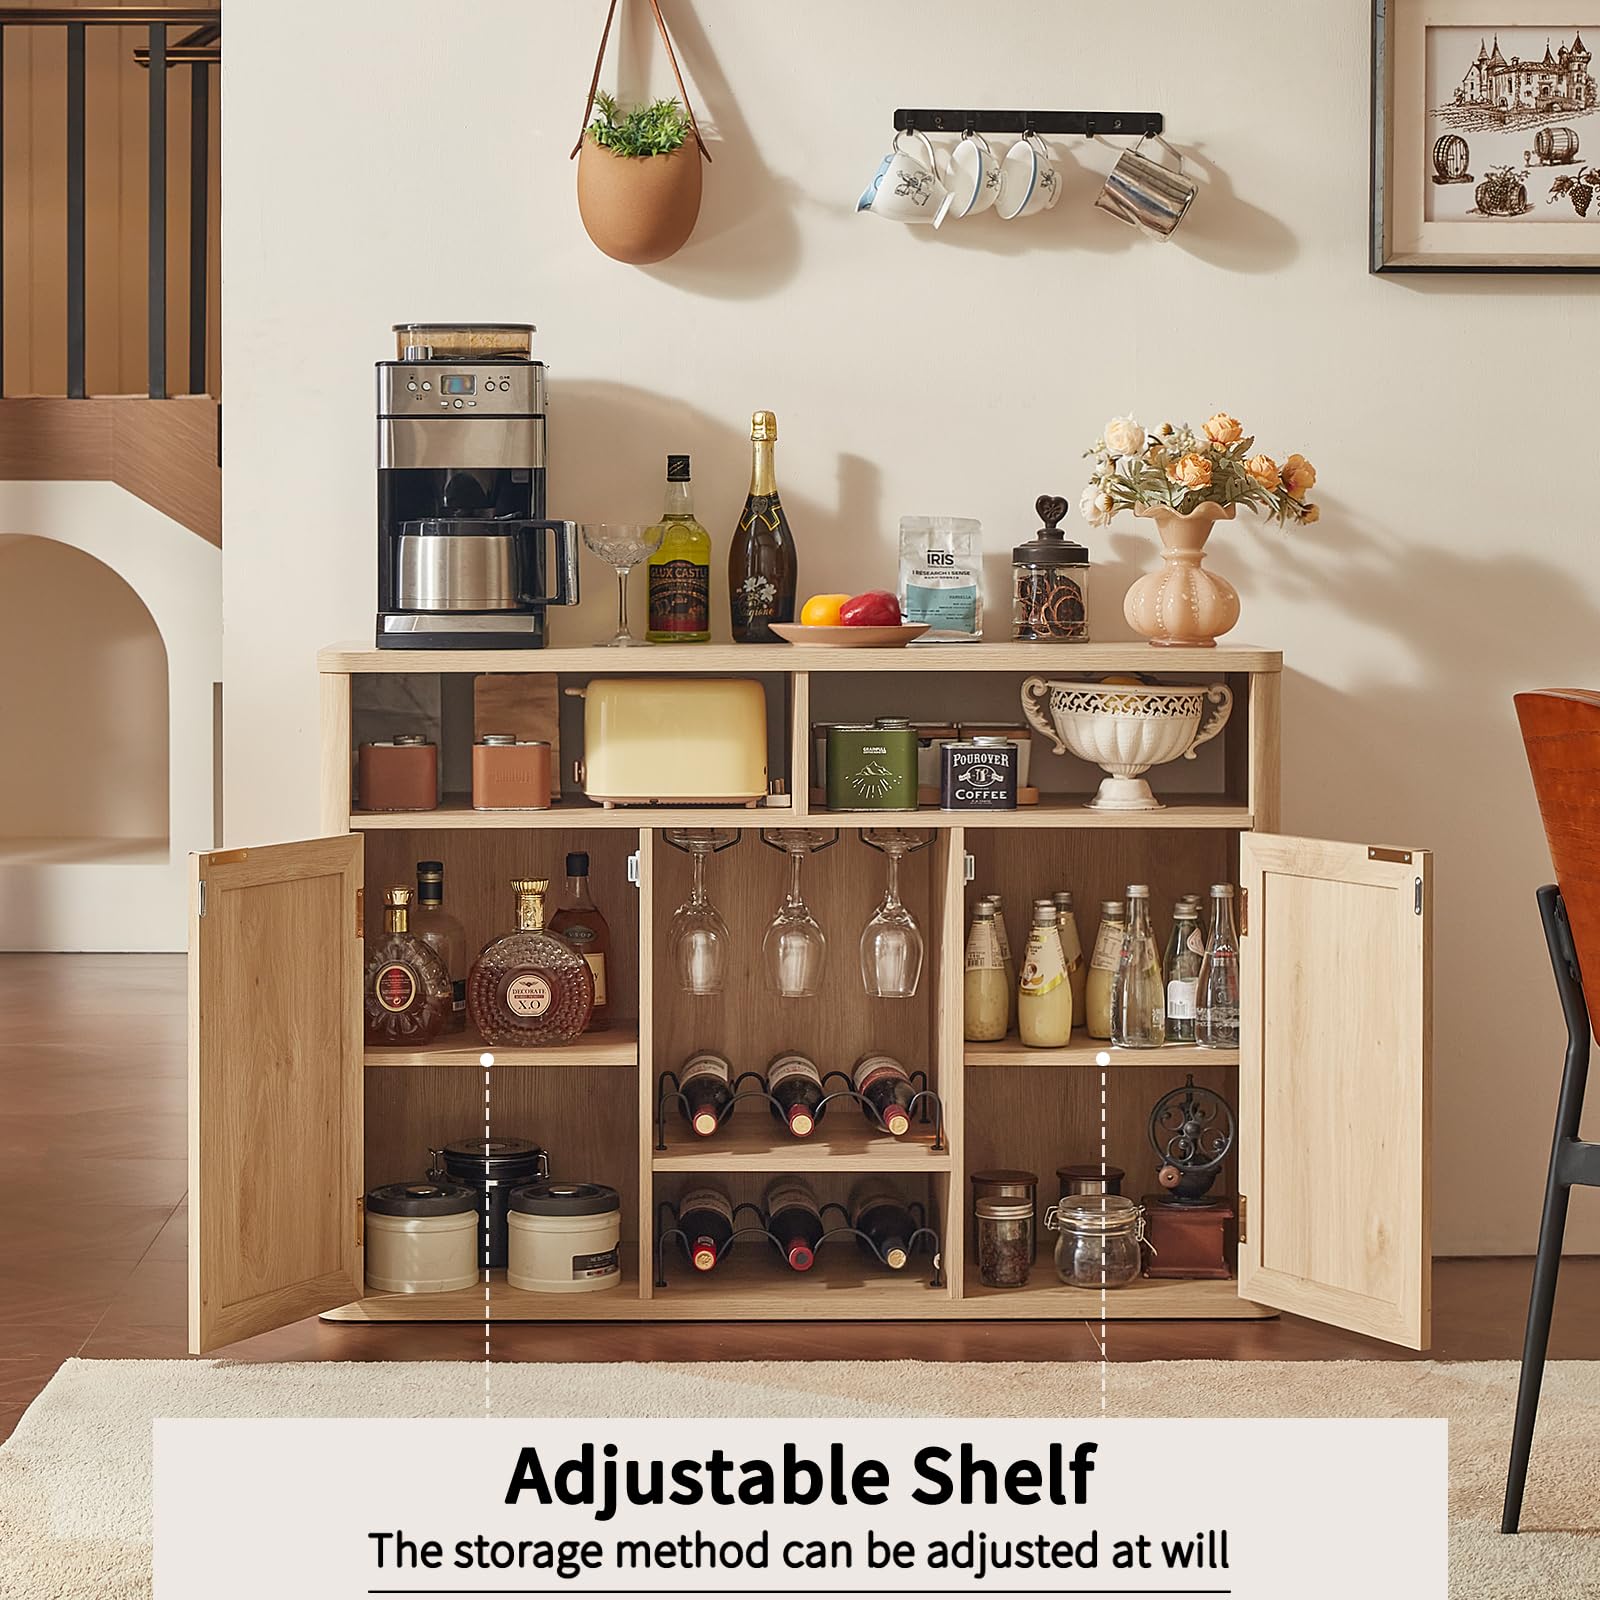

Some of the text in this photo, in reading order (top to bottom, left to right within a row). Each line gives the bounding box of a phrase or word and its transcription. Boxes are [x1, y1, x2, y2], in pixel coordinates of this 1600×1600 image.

[926, 553, 955, 566] IRIS
[953, 753, 1009, 767] POUROVER
[955, 789, 1007, 800] COFFEE
[518, 1000, 540, 1009] X.O
